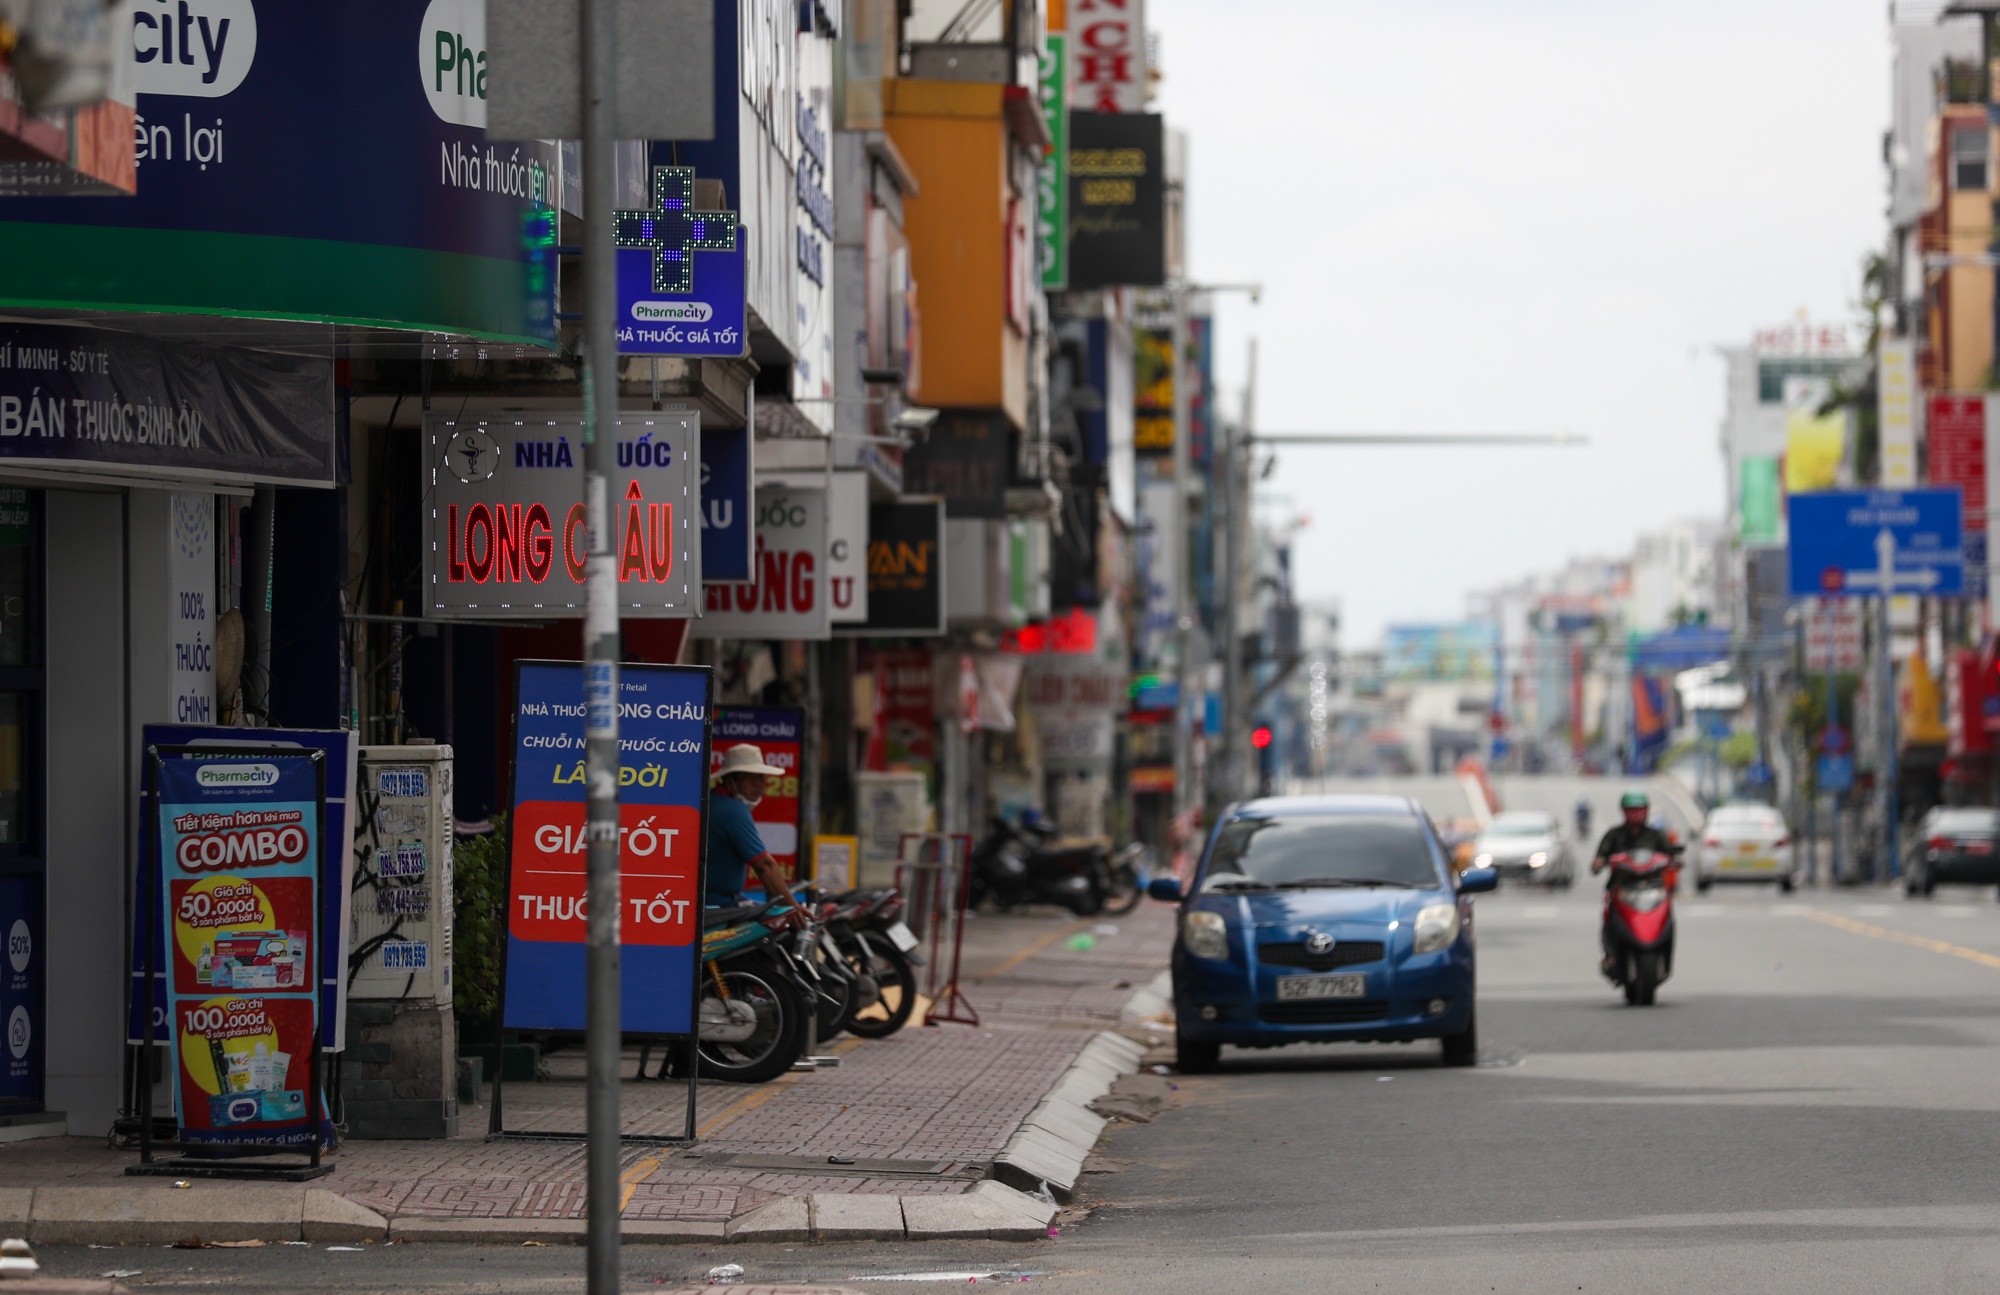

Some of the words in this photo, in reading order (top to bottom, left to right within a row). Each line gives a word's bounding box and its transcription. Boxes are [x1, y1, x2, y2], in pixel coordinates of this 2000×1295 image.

[185, 112, 222, 170] lợi
[442, 141, 480, 190] Nhà
[486, 147, 525, 198] thuốc
[528, 158, 545, 209] tiện
[636, 305, 706, 320] Pharmacity
[637, 326, 683, 343] THUỐC
[687, 329, 710, 343] GIÁ
[713, 327, 738, 344] TỐT
[18, 347, 58, 371] MINH
[70, 350, 87, 373] SỞ
[88, 352, 97, 374] Y
[97, 350, 109, 375] TẾ
[1, 387, 65, 438] BÁN
[73, 393, 132, 443] THUỐC
[137, 397, 175, 446] BÌNH
[178, 399, 200, 449] ỔN
[515, 436, 573, 468] NHÀ
[581, 432, 671, 468] UỐC
[448, 503, 553, 584] LONG
[564, 480, 673, 584] CÂU
[180, 592, 205, 620] 100%
[176, 631, 211, 672] THUỐC
[626, 684, 647, 692] Retail
[178, 689, 210, 723] CHÍNH
[521, 702, 549, 716] NHÀ
[552, 702, 587, 717] THUỐ
[656, 702, 704, 720] CHÂU
[523, 733, 572, 748] CHUỖI
[617, 737, 665, 752] THUỐC
[669, 739, 701, 753] LỚN
[202, 770, 273, 783] Pharmacity
[553, 760, 587, 785] LÂ
[618, 763, 668, 787] ĐỜI
[176, 815, 199, 831] Tiết
[202, 815, 233, 831] kiệm
[236, 812, 261, 825] hơn
[264, 812, 277, 822] khi
[280, 811, 299, 821] mua
[180, 828, 303, 868] COMBO
[617, 816, 679, 857] TỐT
[214, 886, 233, 898] Giá
[236, 884, 252, 896] chỉ
[180, 893, 255, 918] 50.000đ
[518, 891, 621, 921] THUỐ
[630, 890, 690, 924] TỐT
[191, 917, 198, 926] 3
[200, 917, 213, 926] sản
[215, 915, 237, 927] phẩm
[239, 913, 252, 922] bất
[11, 936, 29, 955] 50%
[384, 947, 426, 967] 0979.739.559
[227, 1000, 246, 1011] Giá
[248, 998, 263, 1009] chỉ
[184, 1008, 265, 1032] 100.000đ
[206, 1029, 212, 1039] 3
[213, 1030, 226, 1038] sản
[226, 1027, 248, 1039] phẩm
[288, 1133, 312, 1144] NGA
